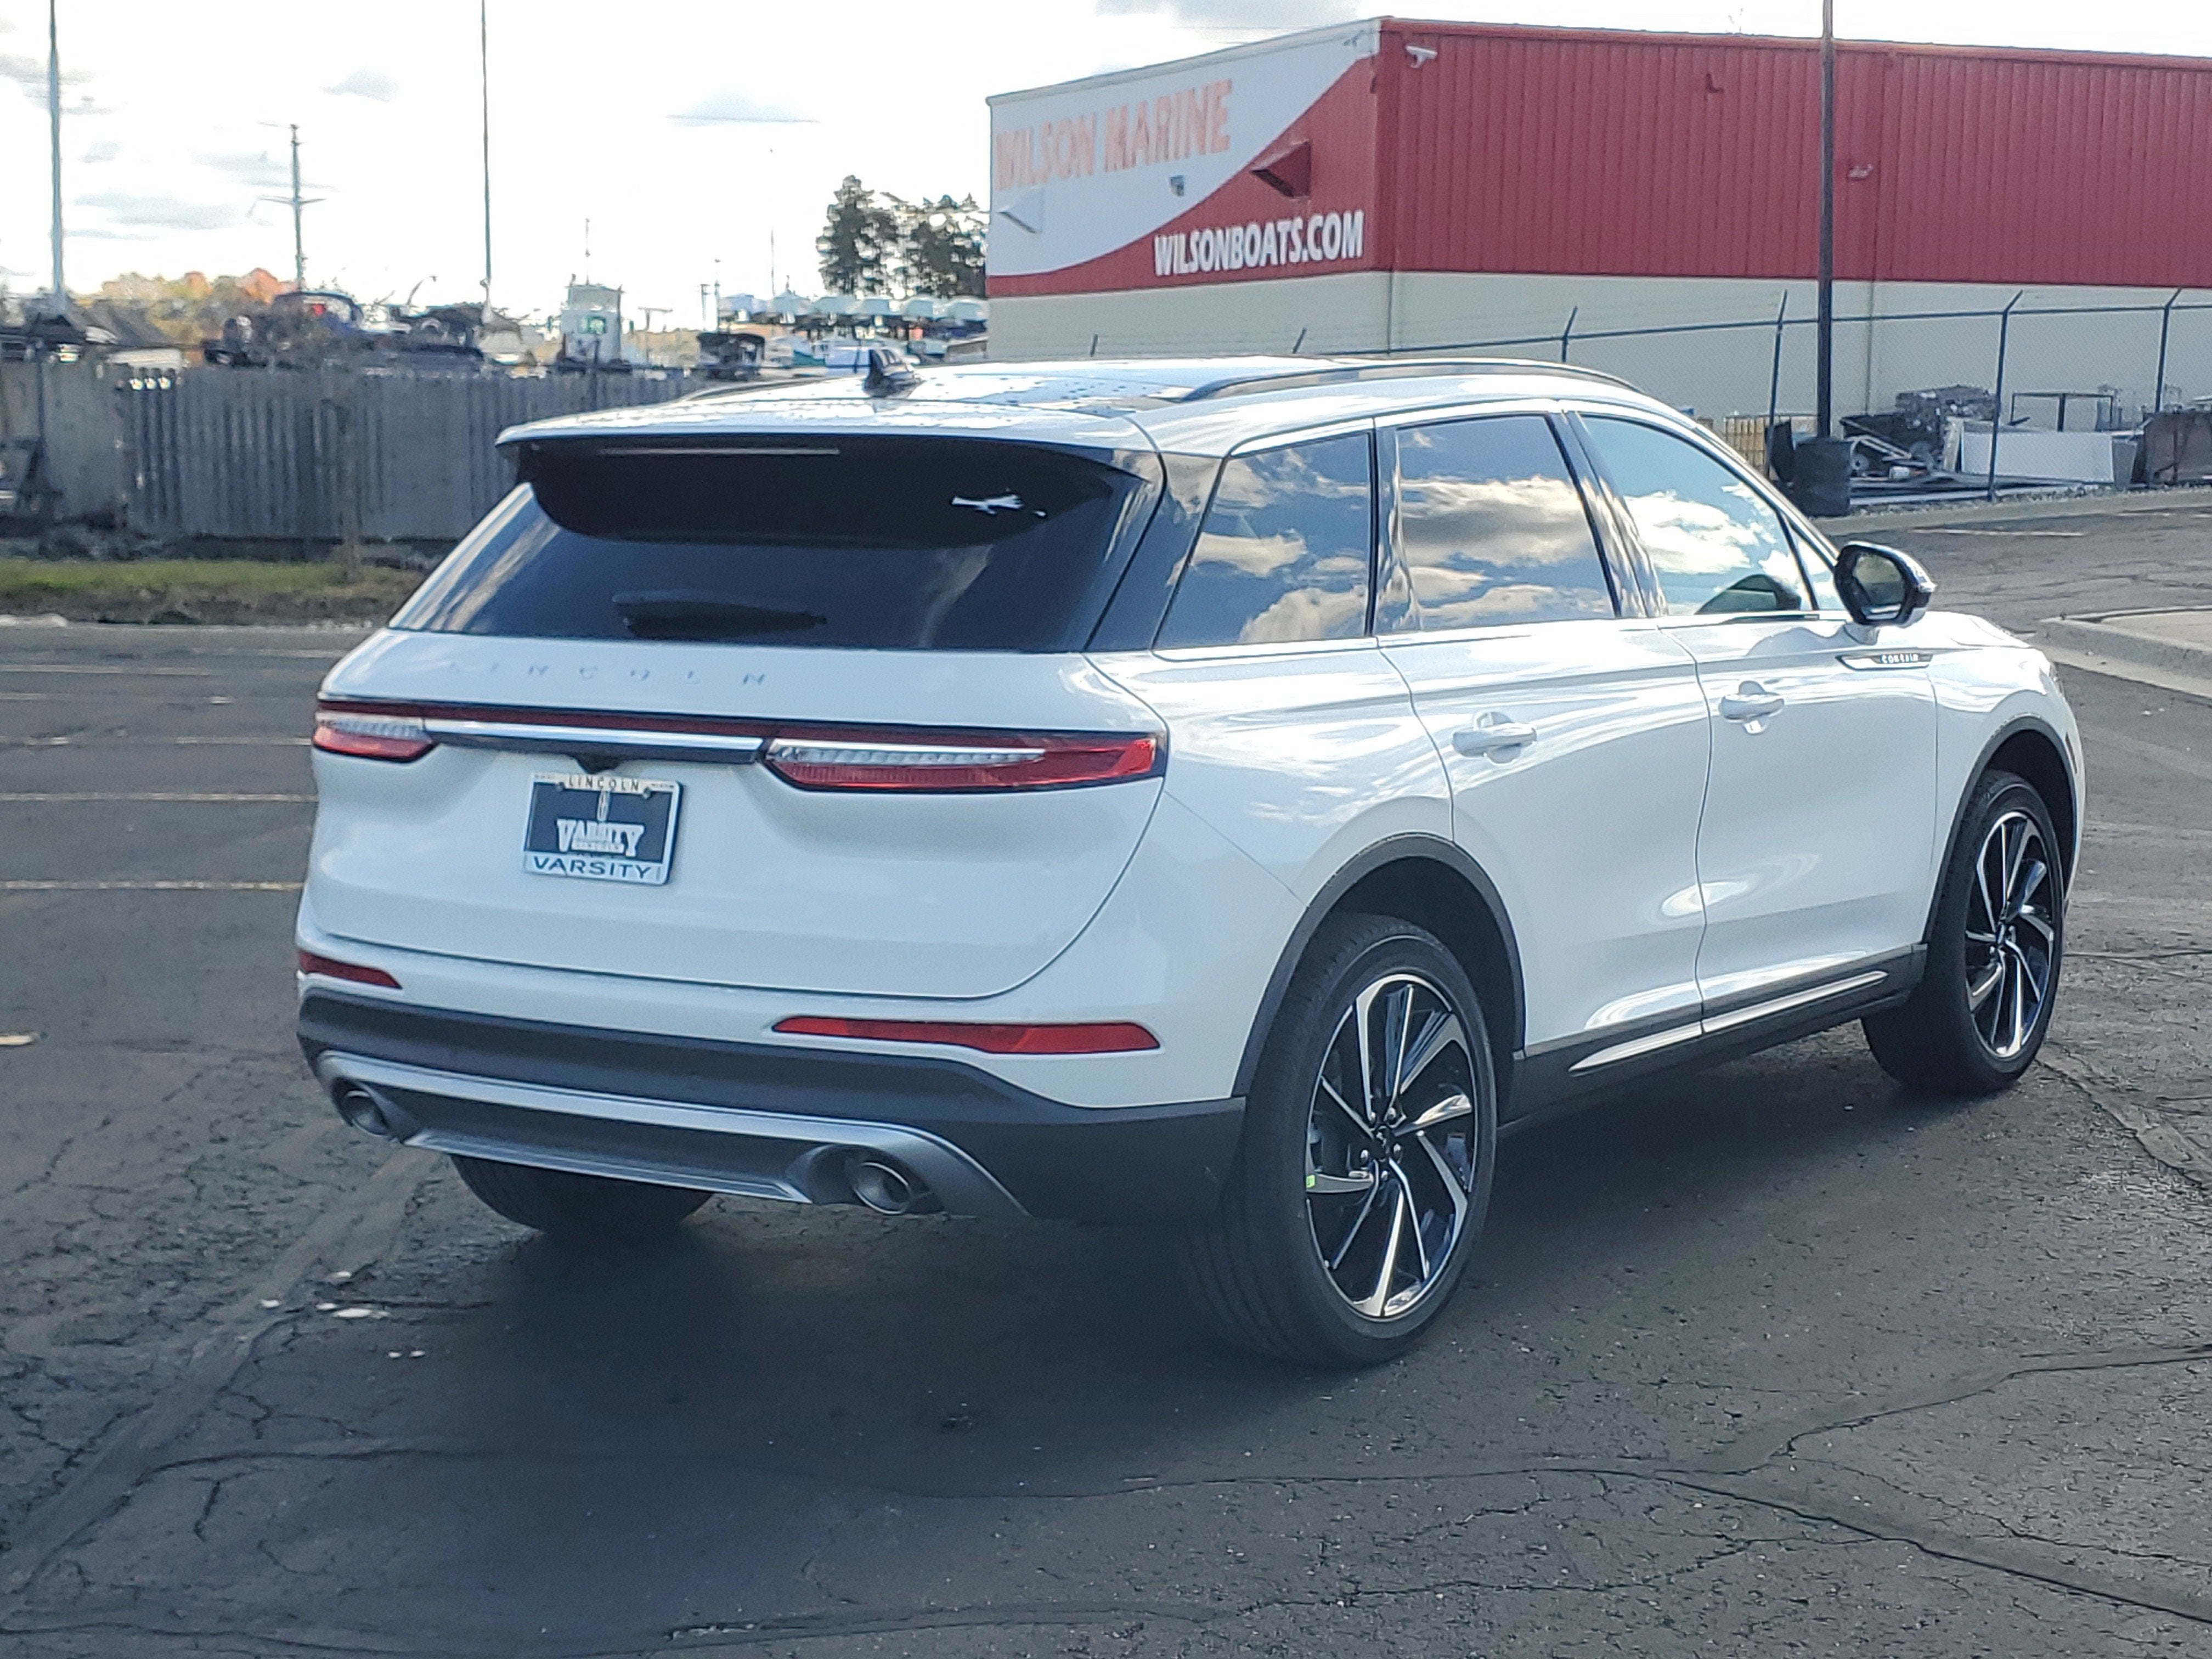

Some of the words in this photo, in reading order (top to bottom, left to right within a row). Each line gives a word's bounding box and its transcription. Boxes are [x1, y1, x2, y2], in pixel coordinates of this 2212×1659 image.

[996, 111, 1096, 191] WILSON
[1104, 78, 1232, 173] MARINE
[1154, 209, 1365, 276] WILSONBOATS.COM
[568, 776, 639, 791] LINCOLN
[534, 856, 651, 878] VARSITY
